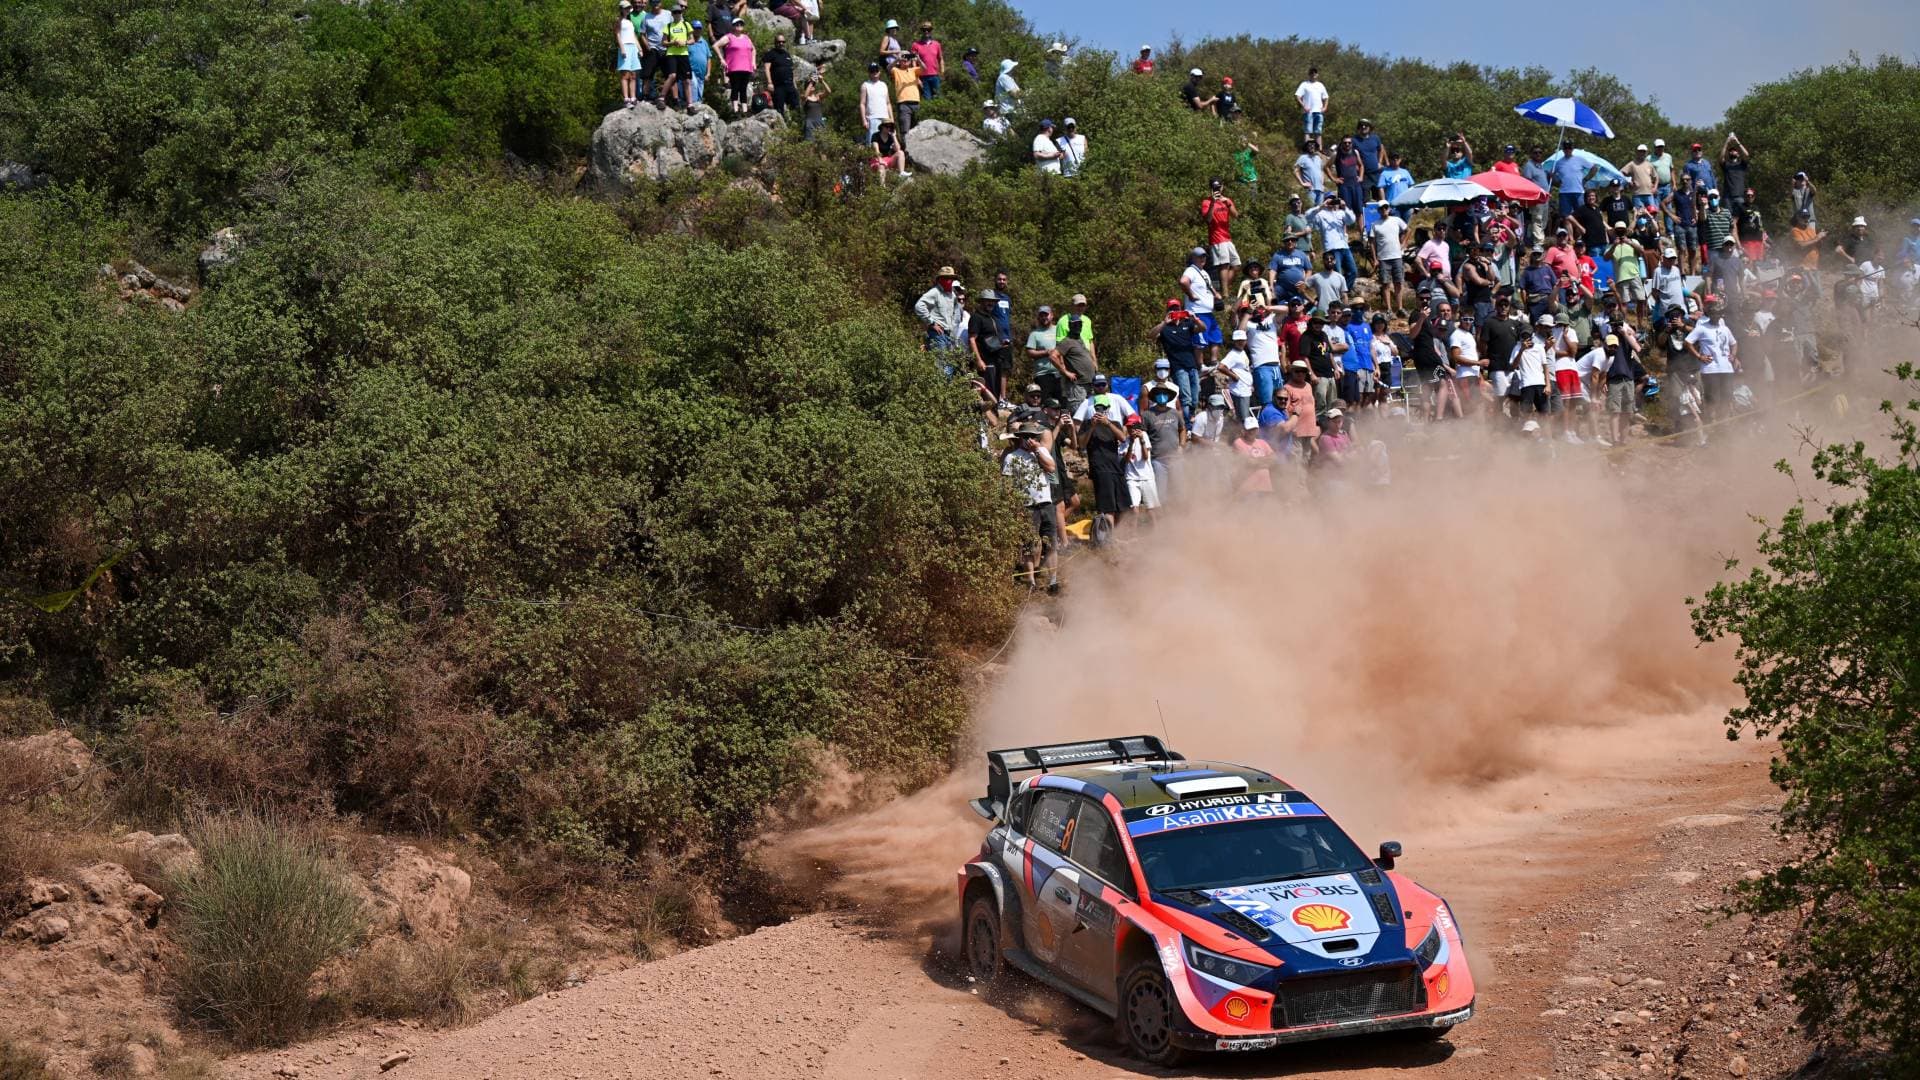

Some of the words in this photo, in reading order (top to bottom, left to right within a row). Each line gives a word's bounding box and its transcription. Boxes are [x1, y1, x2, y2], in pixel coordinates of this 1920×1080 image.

[1179, 795, 1251, 810] HYUNDAI
[1061, 818, 1075, 850] 8
[1248, 882, 1311, 893] HYUNDAI
[1268, 885, 1359, 901] MOBIS
